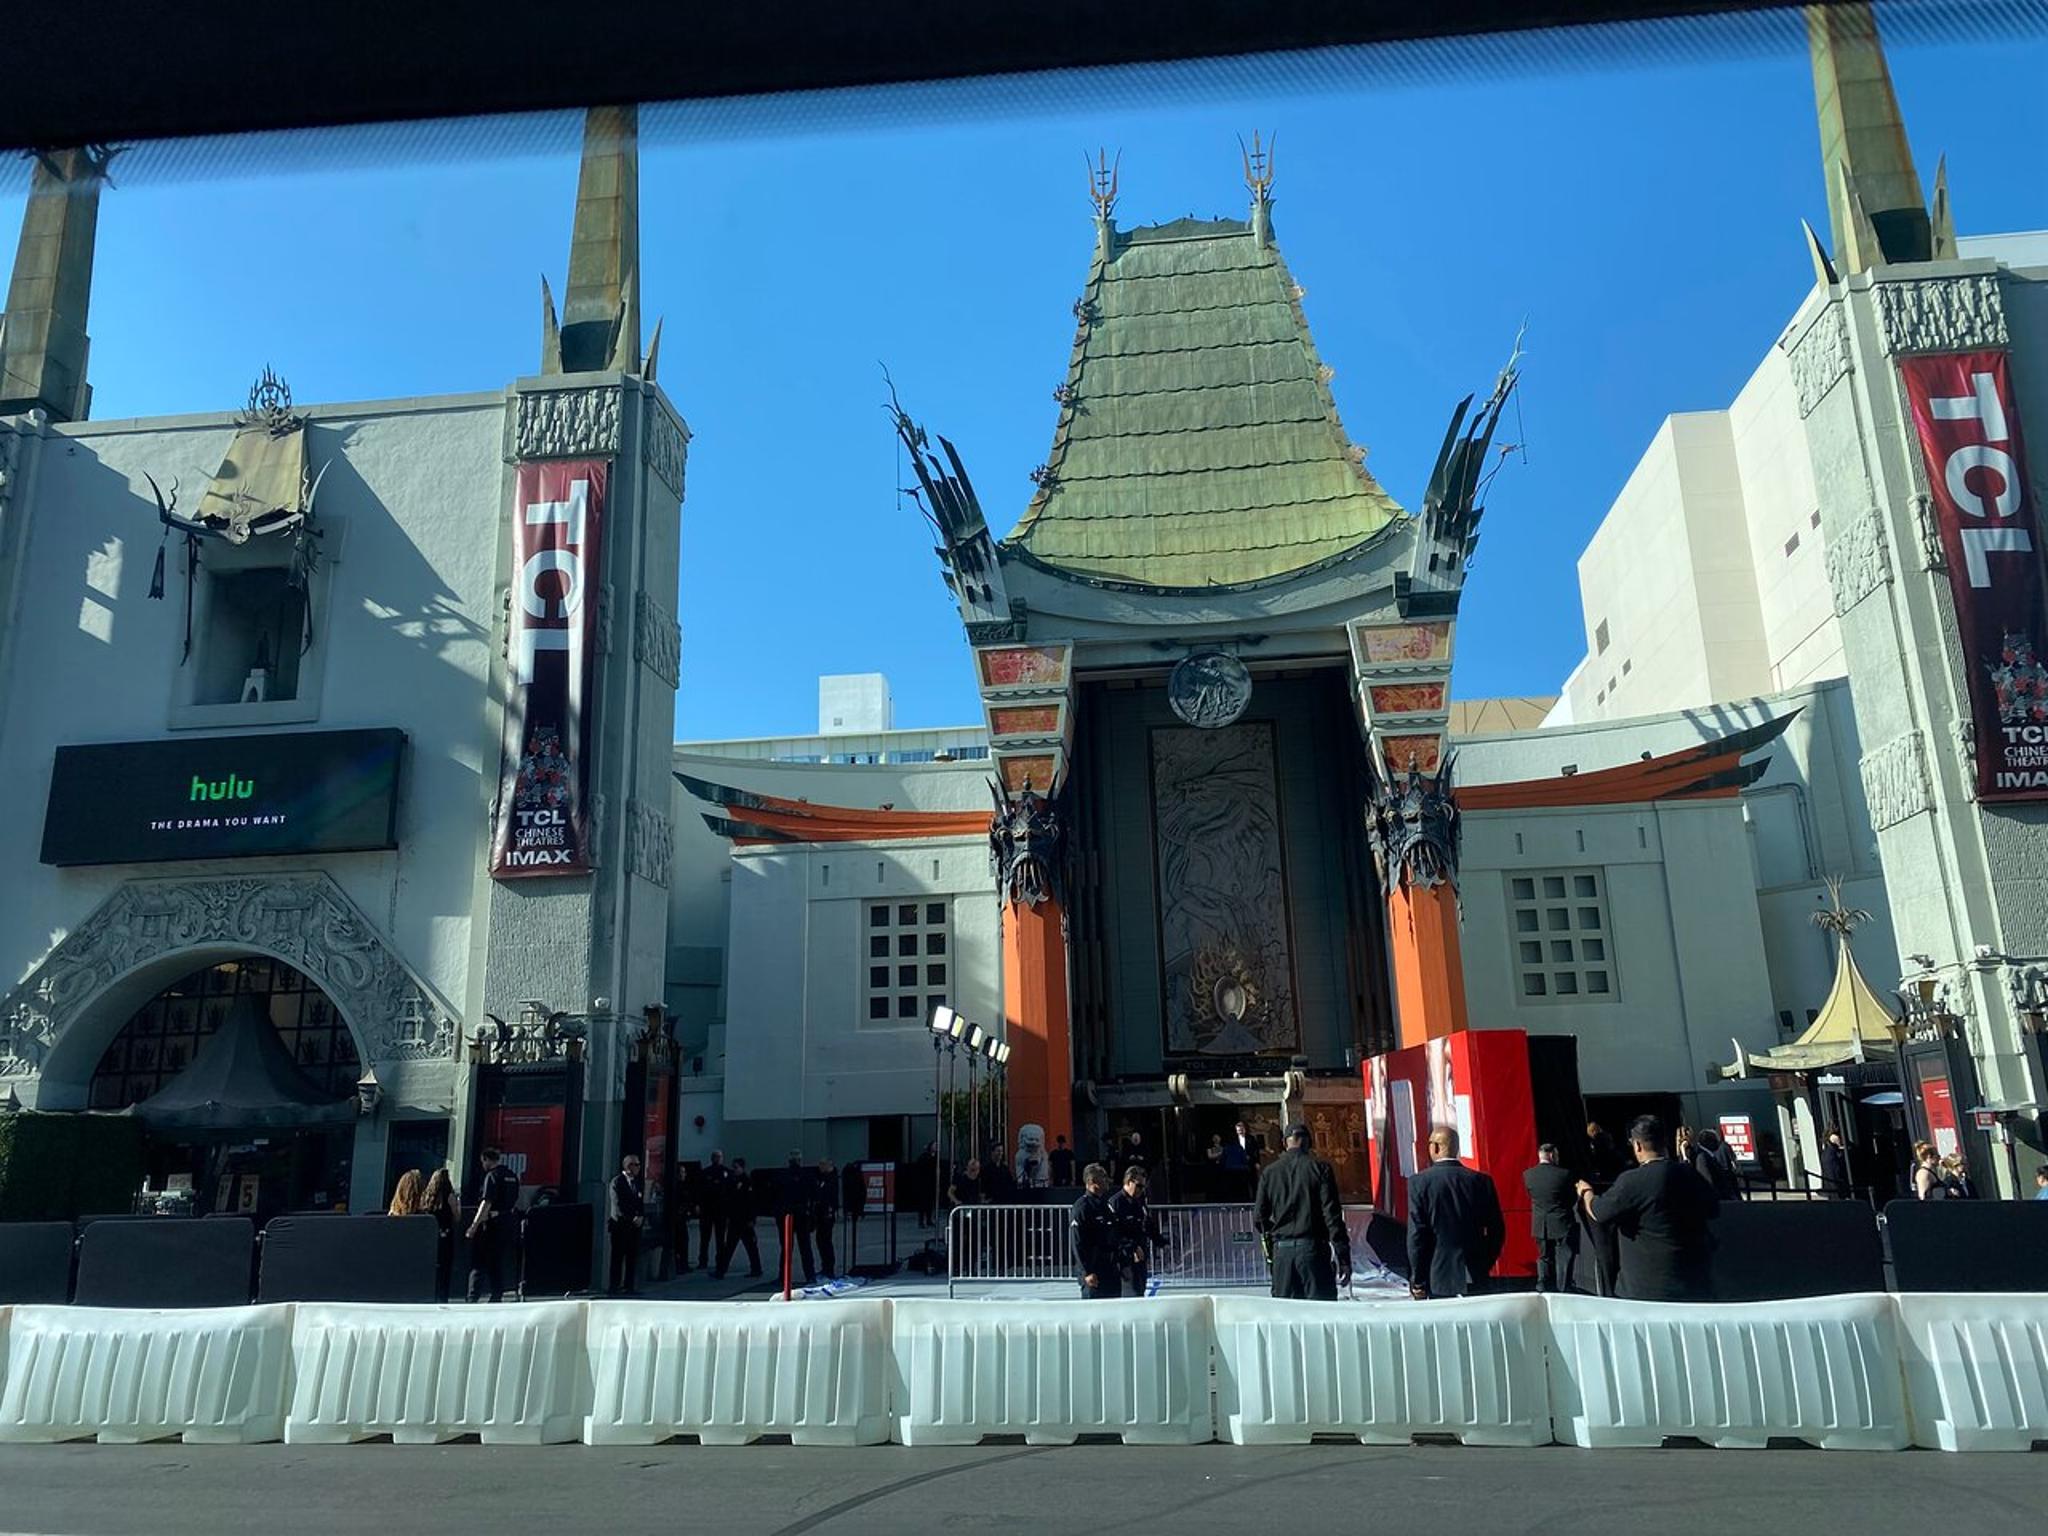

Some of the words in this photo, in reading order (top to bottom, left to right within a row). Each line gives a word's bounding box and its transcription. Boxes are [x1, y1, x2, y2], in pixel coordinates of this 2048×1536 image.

[1929, 372, 2033, 589] TCL
[518, 479, 589, 684] TCL
[190, 773, 254, 800] hulu
[151, 821, 173, 830] THE
[177, 819, 219, 829] DRAMA
[225, 817, 248, 826] YOU
[253, 815, 286, 825] WANT
[516, 810, 566, 826] TCL
[515, 827, 564, 838] CHINESE
[505, 849, 571, 866] IMAX
